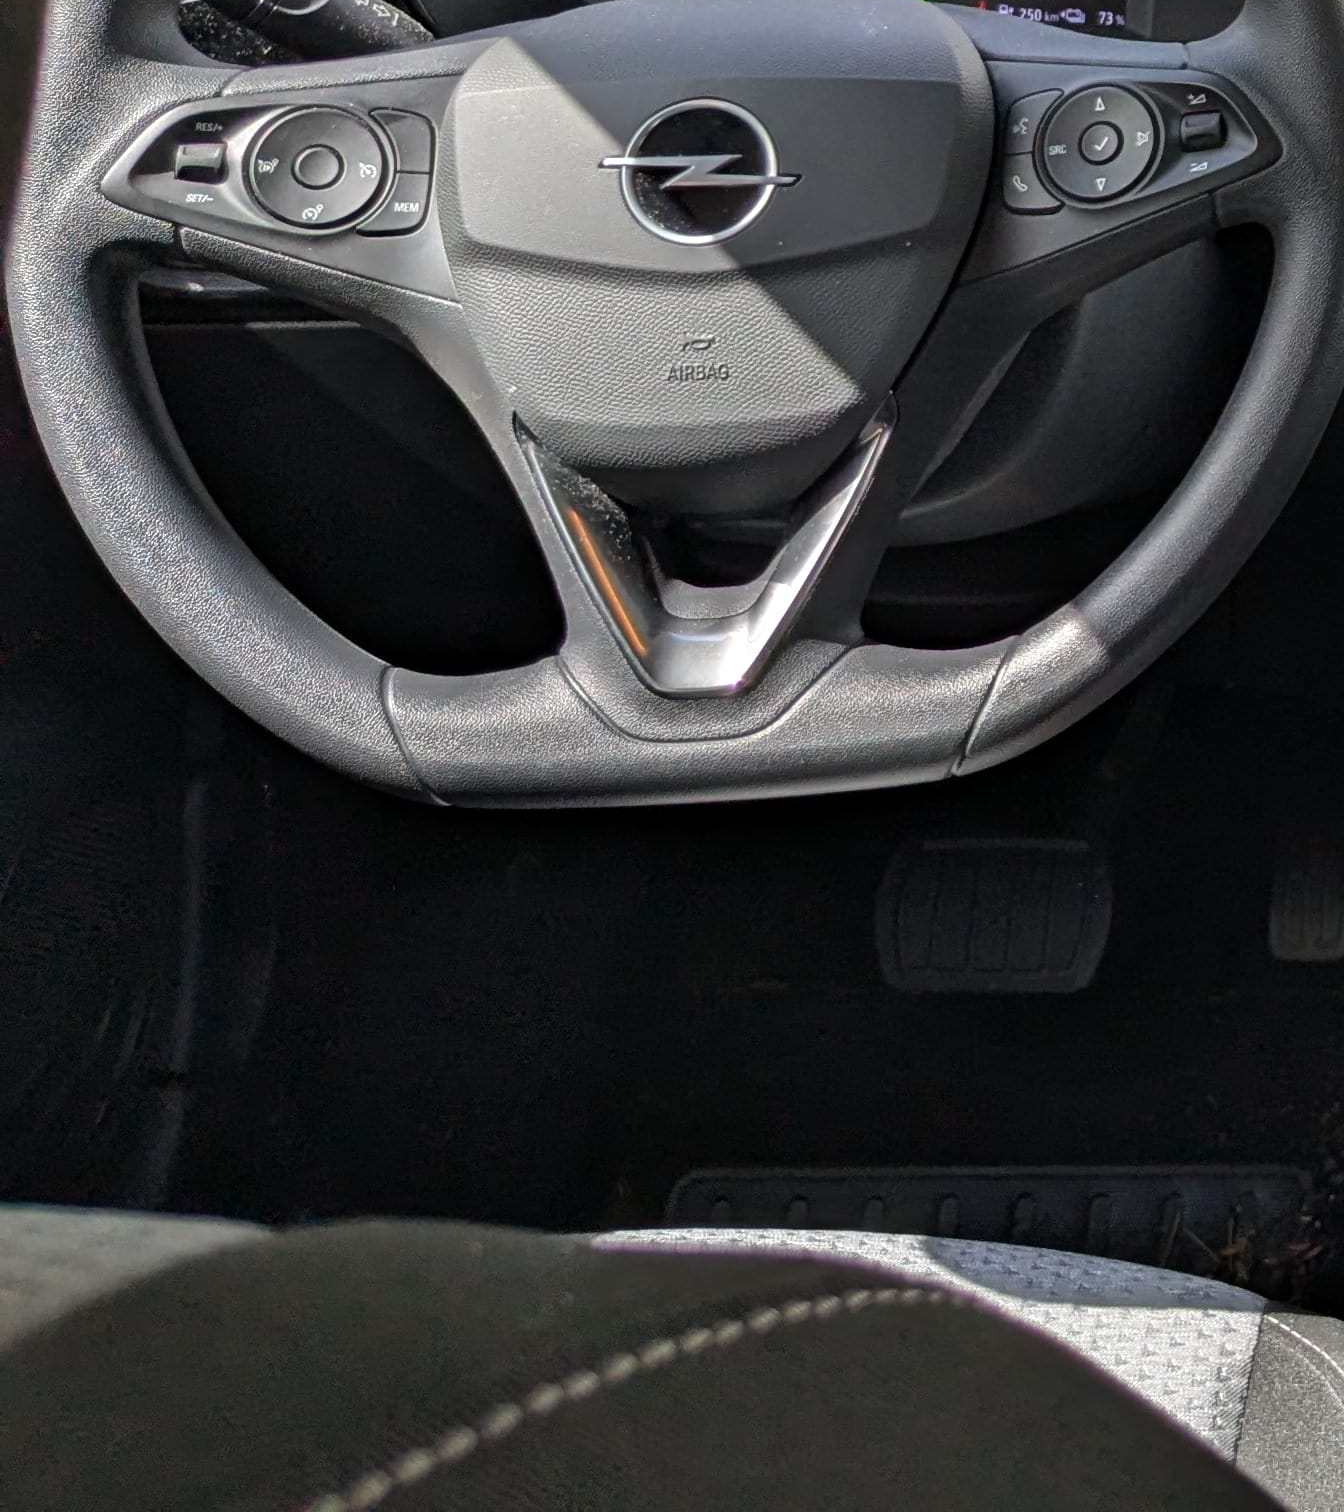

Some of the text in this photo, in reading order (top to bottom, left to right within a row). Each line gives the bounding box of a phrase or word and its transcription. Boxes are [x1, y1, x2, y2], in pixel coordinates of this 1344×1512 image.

[1099, 11, 1114, 26] 73
[195, 122, 224, 132] RES/+
[1048, 144, 1068, 155] SRC
[394, 202, 420, 213] MEM
[667, 364, 730, 382] AIRBAG
